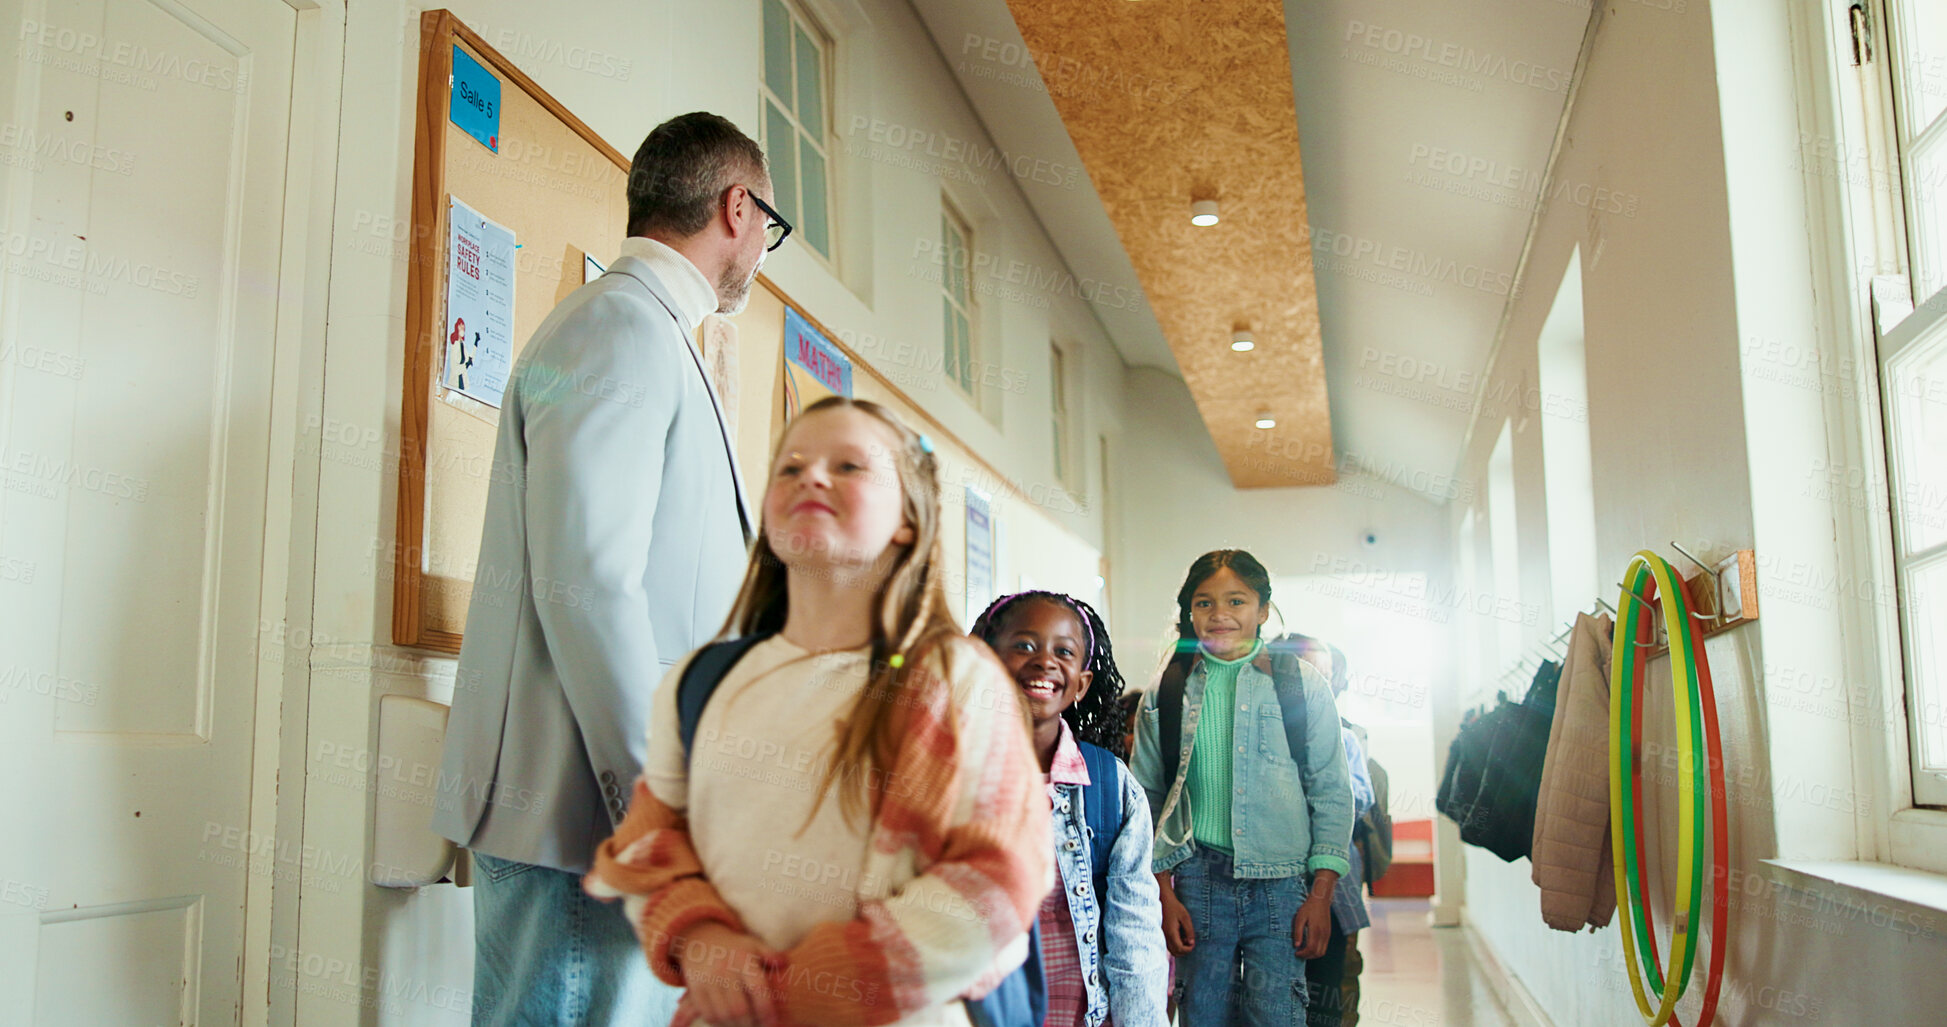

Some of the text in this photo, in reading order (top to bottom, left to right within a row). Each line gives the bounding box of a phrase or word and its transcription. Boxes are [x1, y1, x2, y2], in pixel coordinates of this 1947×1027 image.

[460, 81, 493, 119] Salle 5
[457, 243, 481, 266] SAFETY
[457, 256, 480, 281] RULES
[798, 333, 842, 394] MATHS
